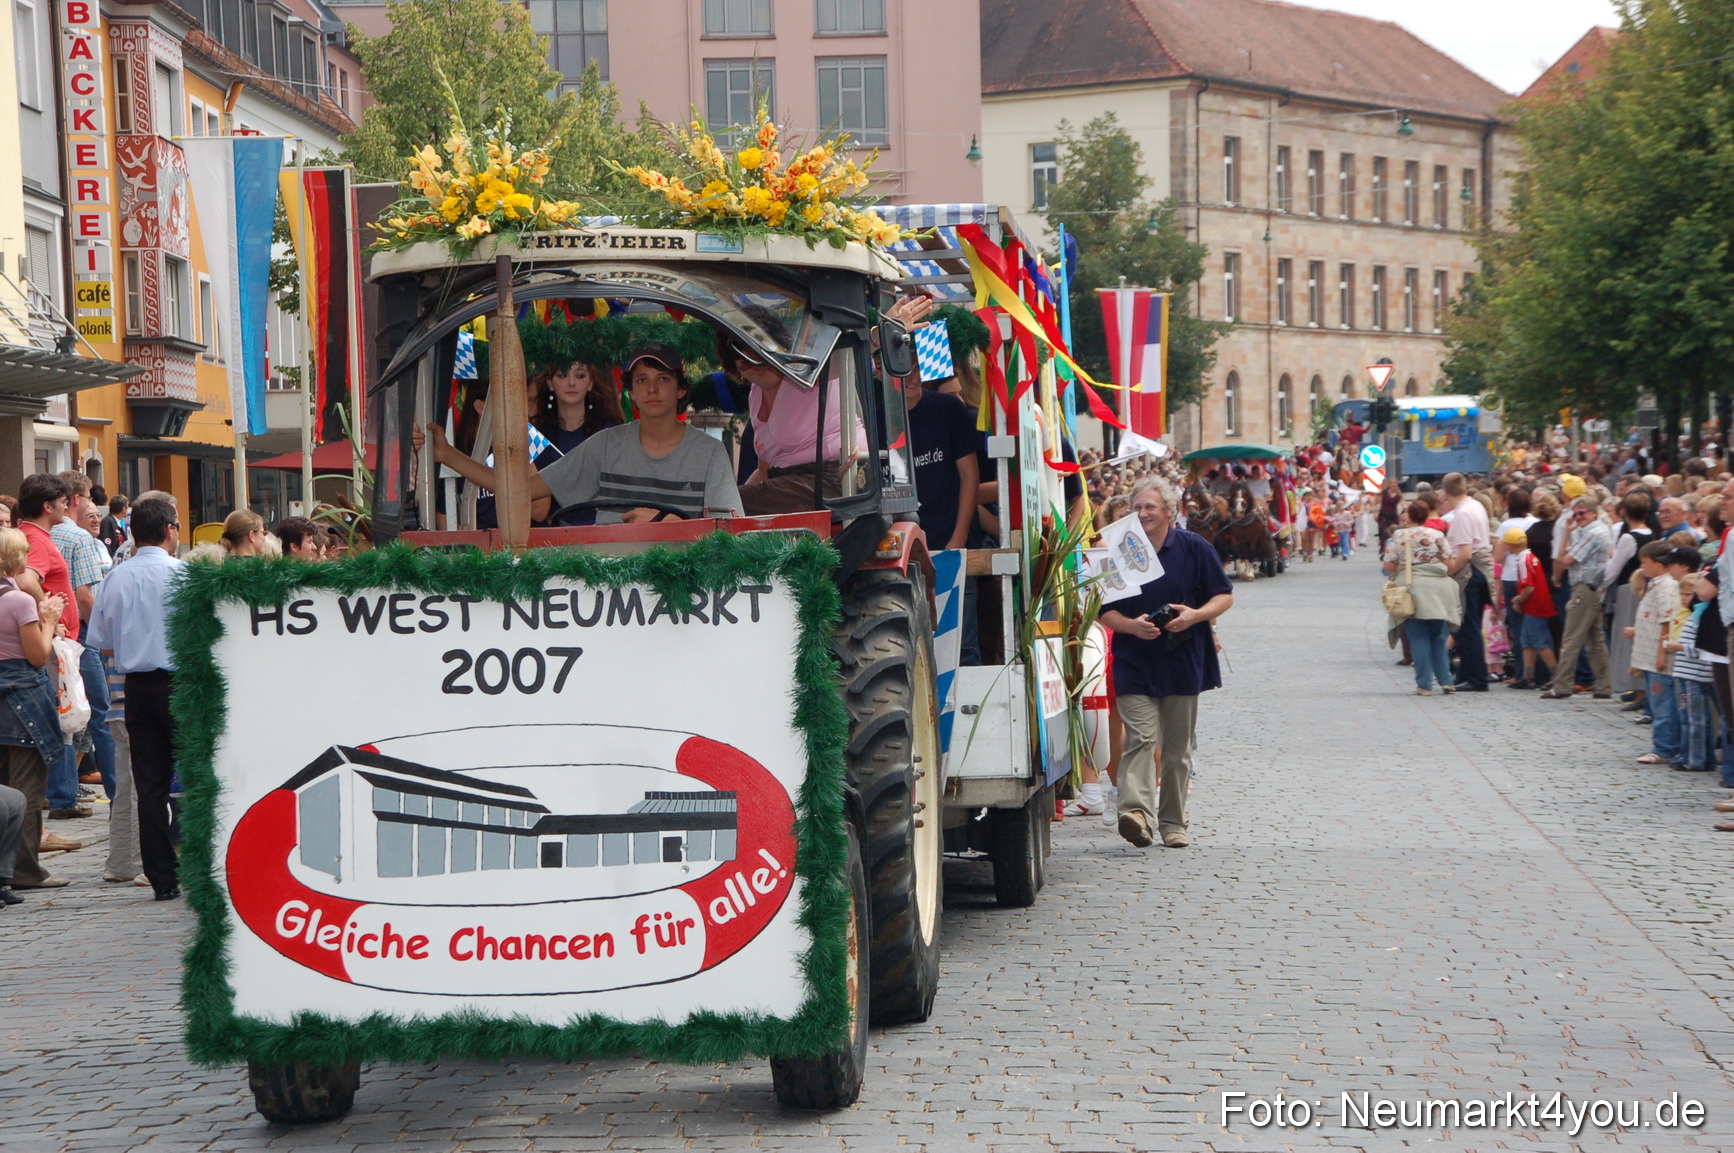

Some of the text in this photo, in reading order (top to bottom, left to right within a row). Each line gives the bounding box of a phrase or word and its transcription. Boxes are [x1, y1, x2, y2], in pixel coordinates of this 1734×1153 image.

[67, 2, 101, 270] BÄCKEREI
[77, 284, 111, 303] café
[79, 321, 112, 337] plank
[250, 585, 773, 636] HS WEST NEUMARKT
[441, 647, 583, 695] 2007
[275, 848, 788, 961] Gleiche Chancen für alle!
